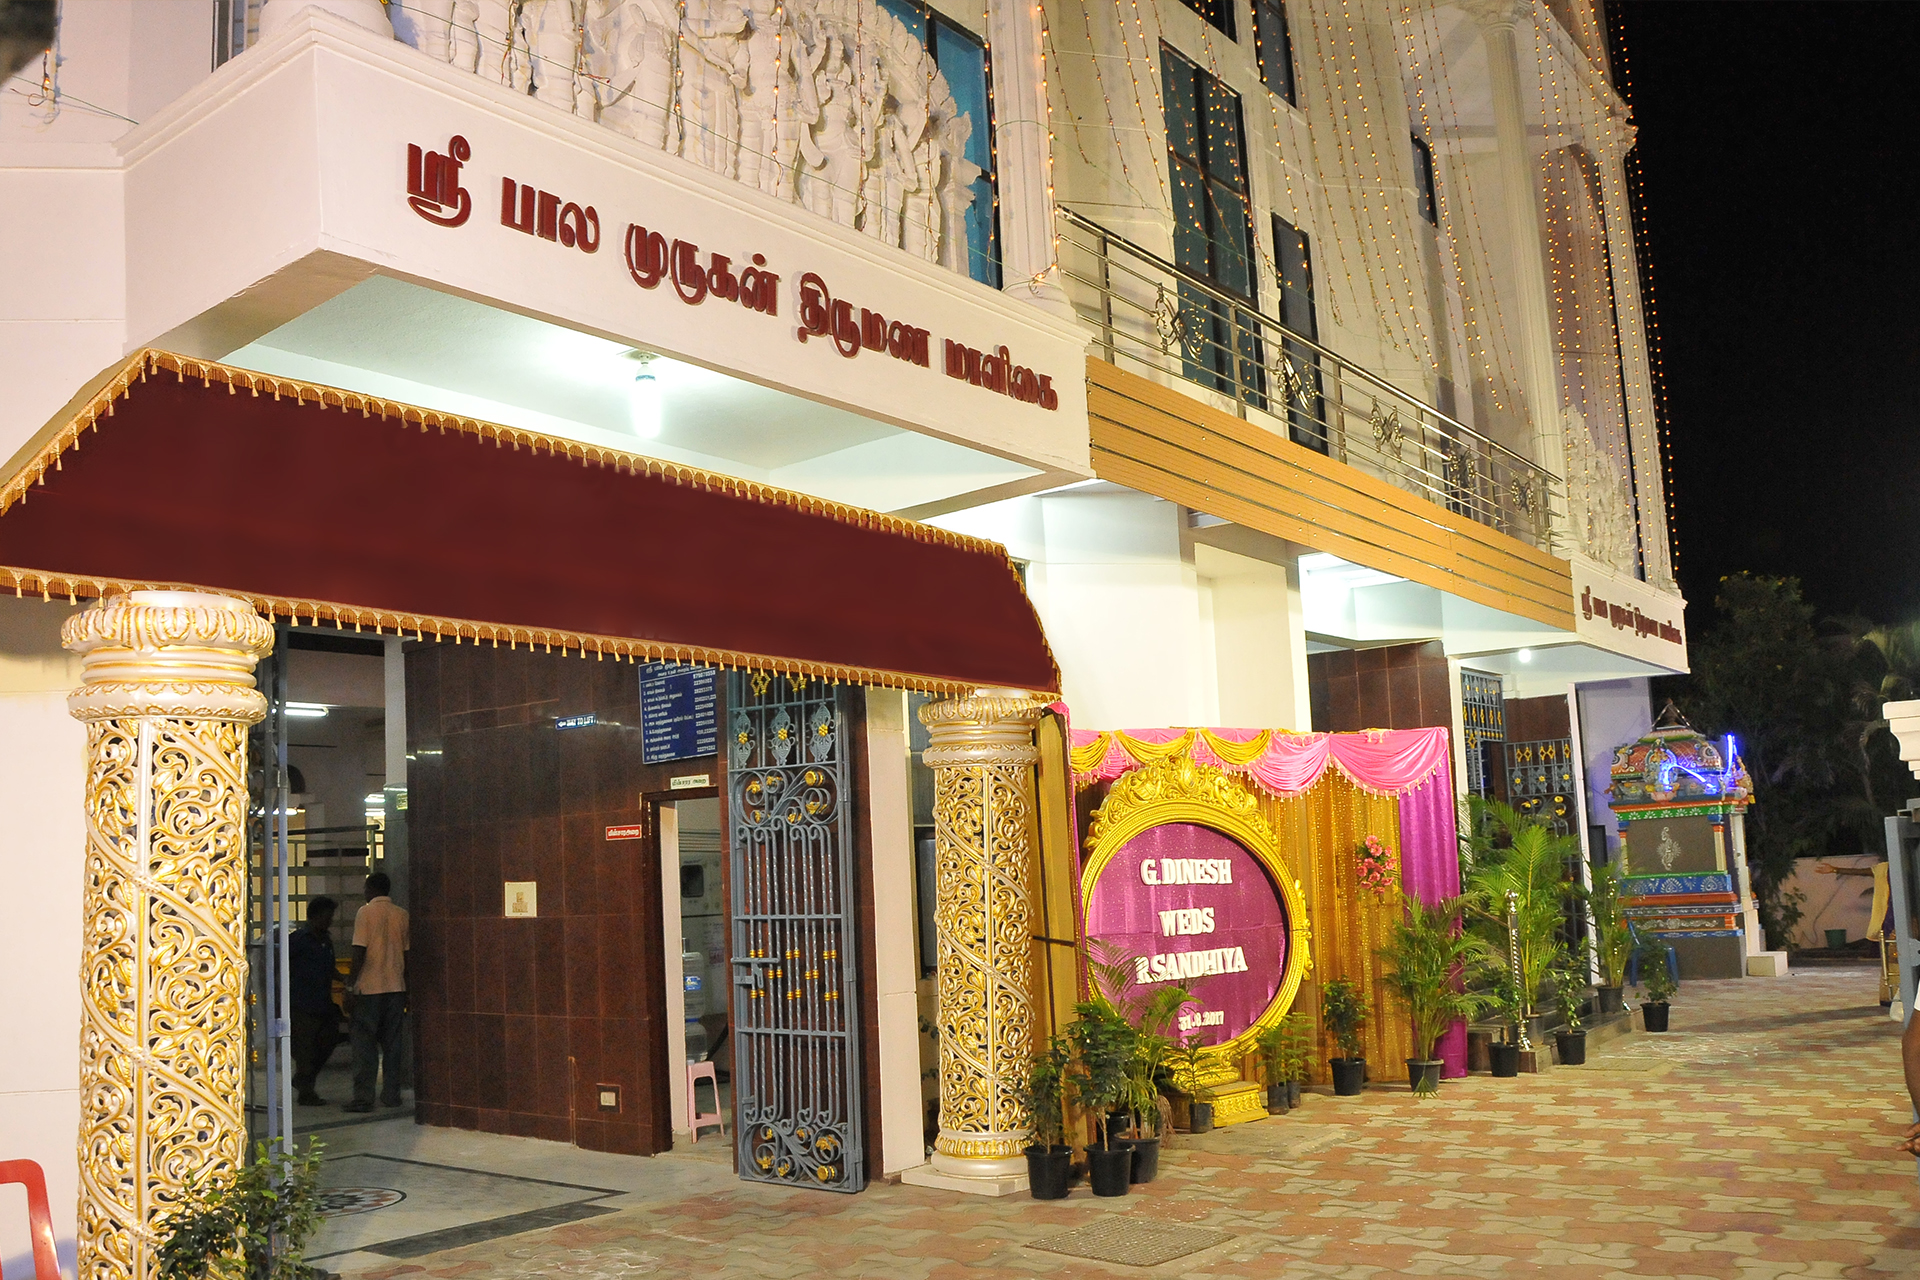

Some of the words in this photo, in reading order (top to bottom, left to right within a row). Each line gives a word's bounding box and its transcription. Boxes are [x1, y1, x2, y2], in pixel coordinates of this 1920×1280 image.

[407, 134, 472, 228] ஸ்ரீ
[501, 176, 600, 254] பால
[625, 222, 781, 316] முருகன்
[797, 272, 931, 368] திருமண
[945, 338, 1058, 412] மாளிகை
[577, 717, 584, 726] TO
[584, 715, 594, 724] LIFT
[1140, 858, 1233, 885] G.DINESH
[1158, 907, 1215, 937] WEDS
[1178, 1010, 1225, 1031] 31.8.2017
